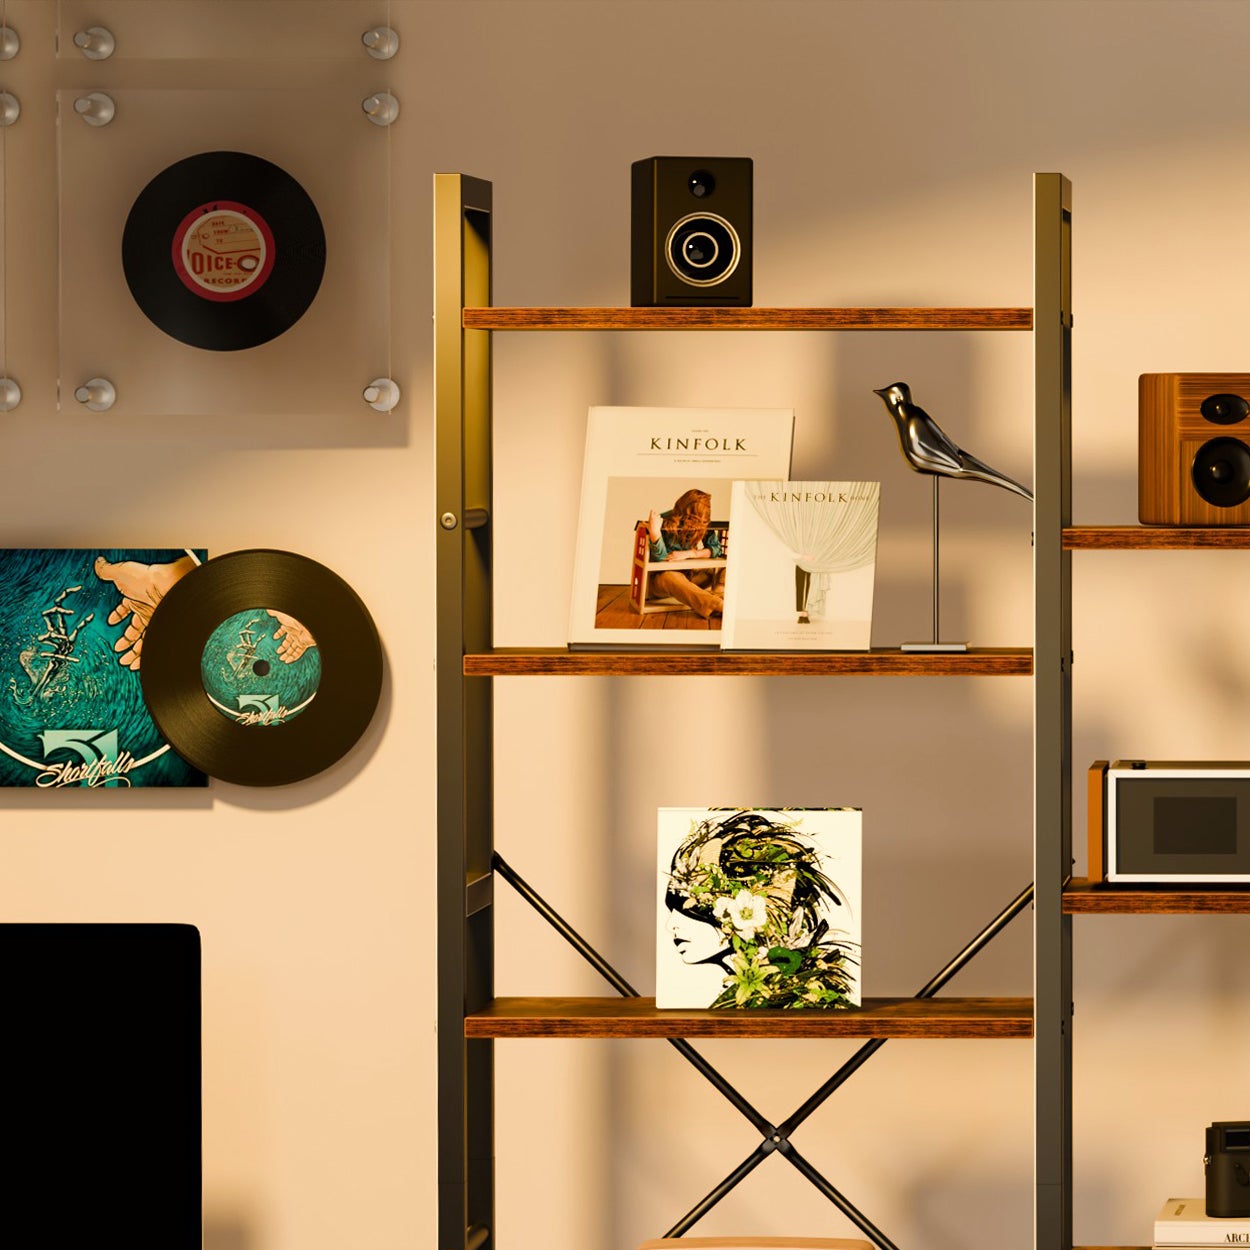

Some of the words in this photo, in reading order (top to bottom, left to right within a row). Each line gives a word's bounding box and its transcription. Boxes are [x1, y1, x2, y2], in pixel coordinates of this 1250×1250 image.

[650, 438, 746, 451] KINFOLK
[770, 492, 847, 502] KINFOLK
[36, 751, 135, 788] Shortfalls
